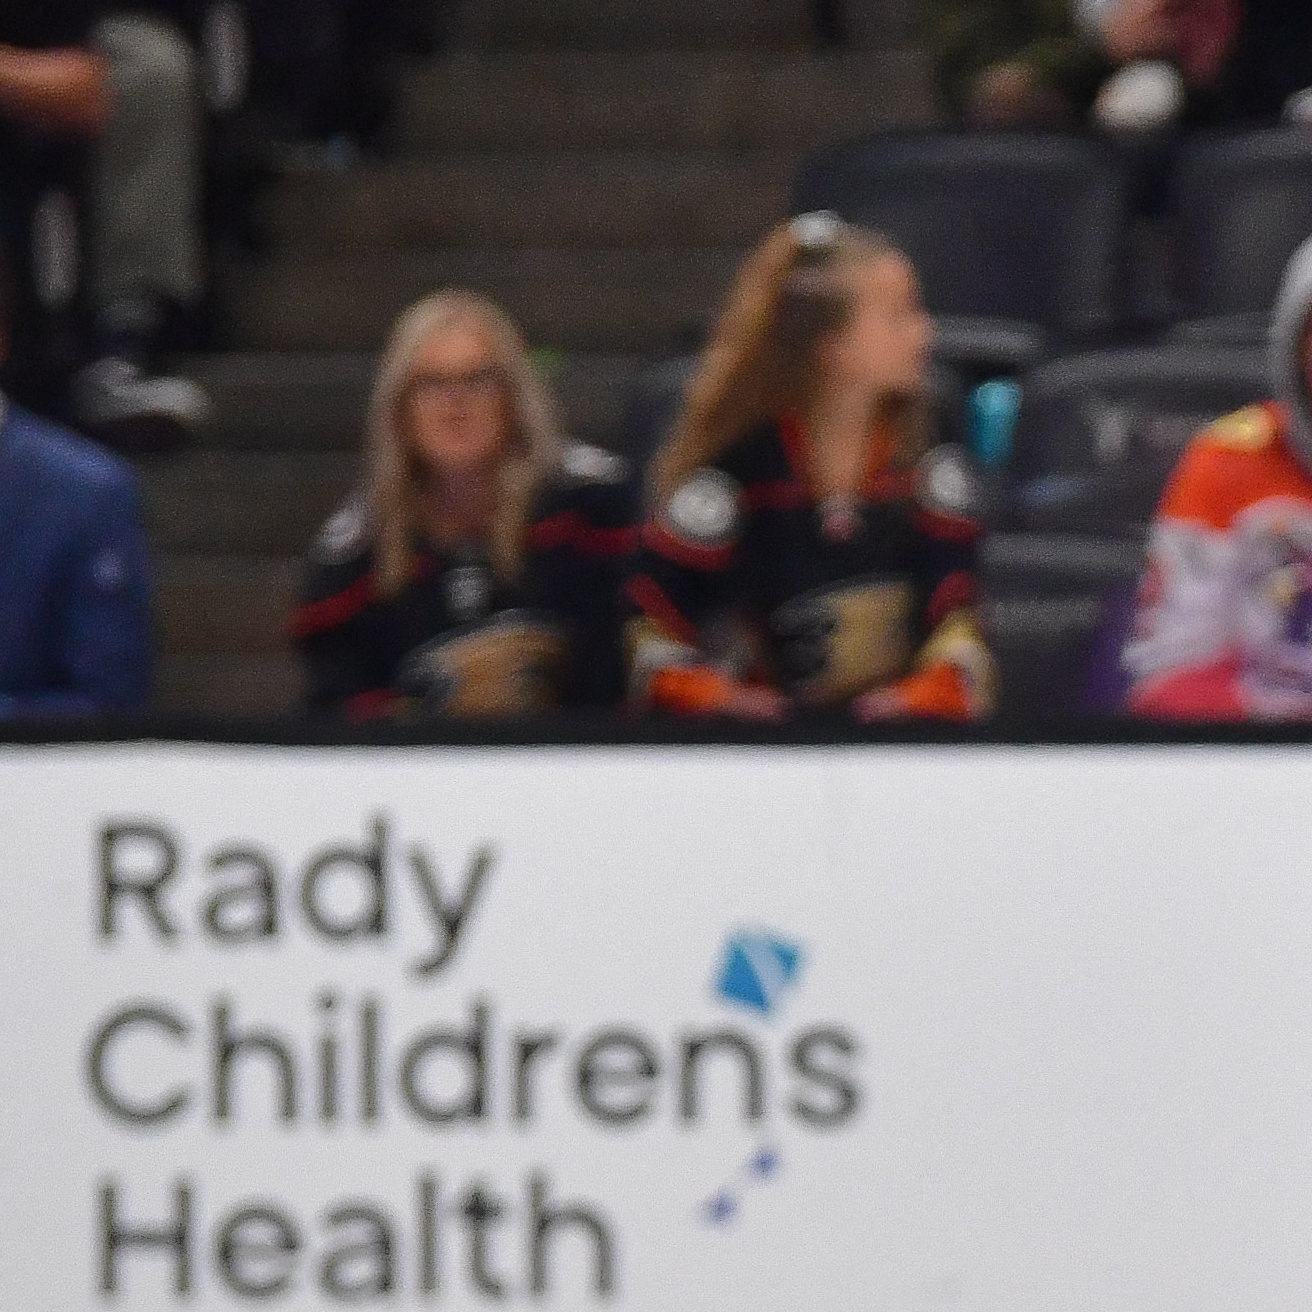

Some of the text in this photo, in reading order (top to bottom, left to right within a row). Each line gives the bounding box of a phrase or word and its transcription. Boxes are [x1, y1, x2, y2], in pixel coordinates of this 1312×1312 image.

[93, 814, 496, 980] Rady
[84, 992, 863, 1130] Childrens
[94, 1170, 617, 1303] Health
